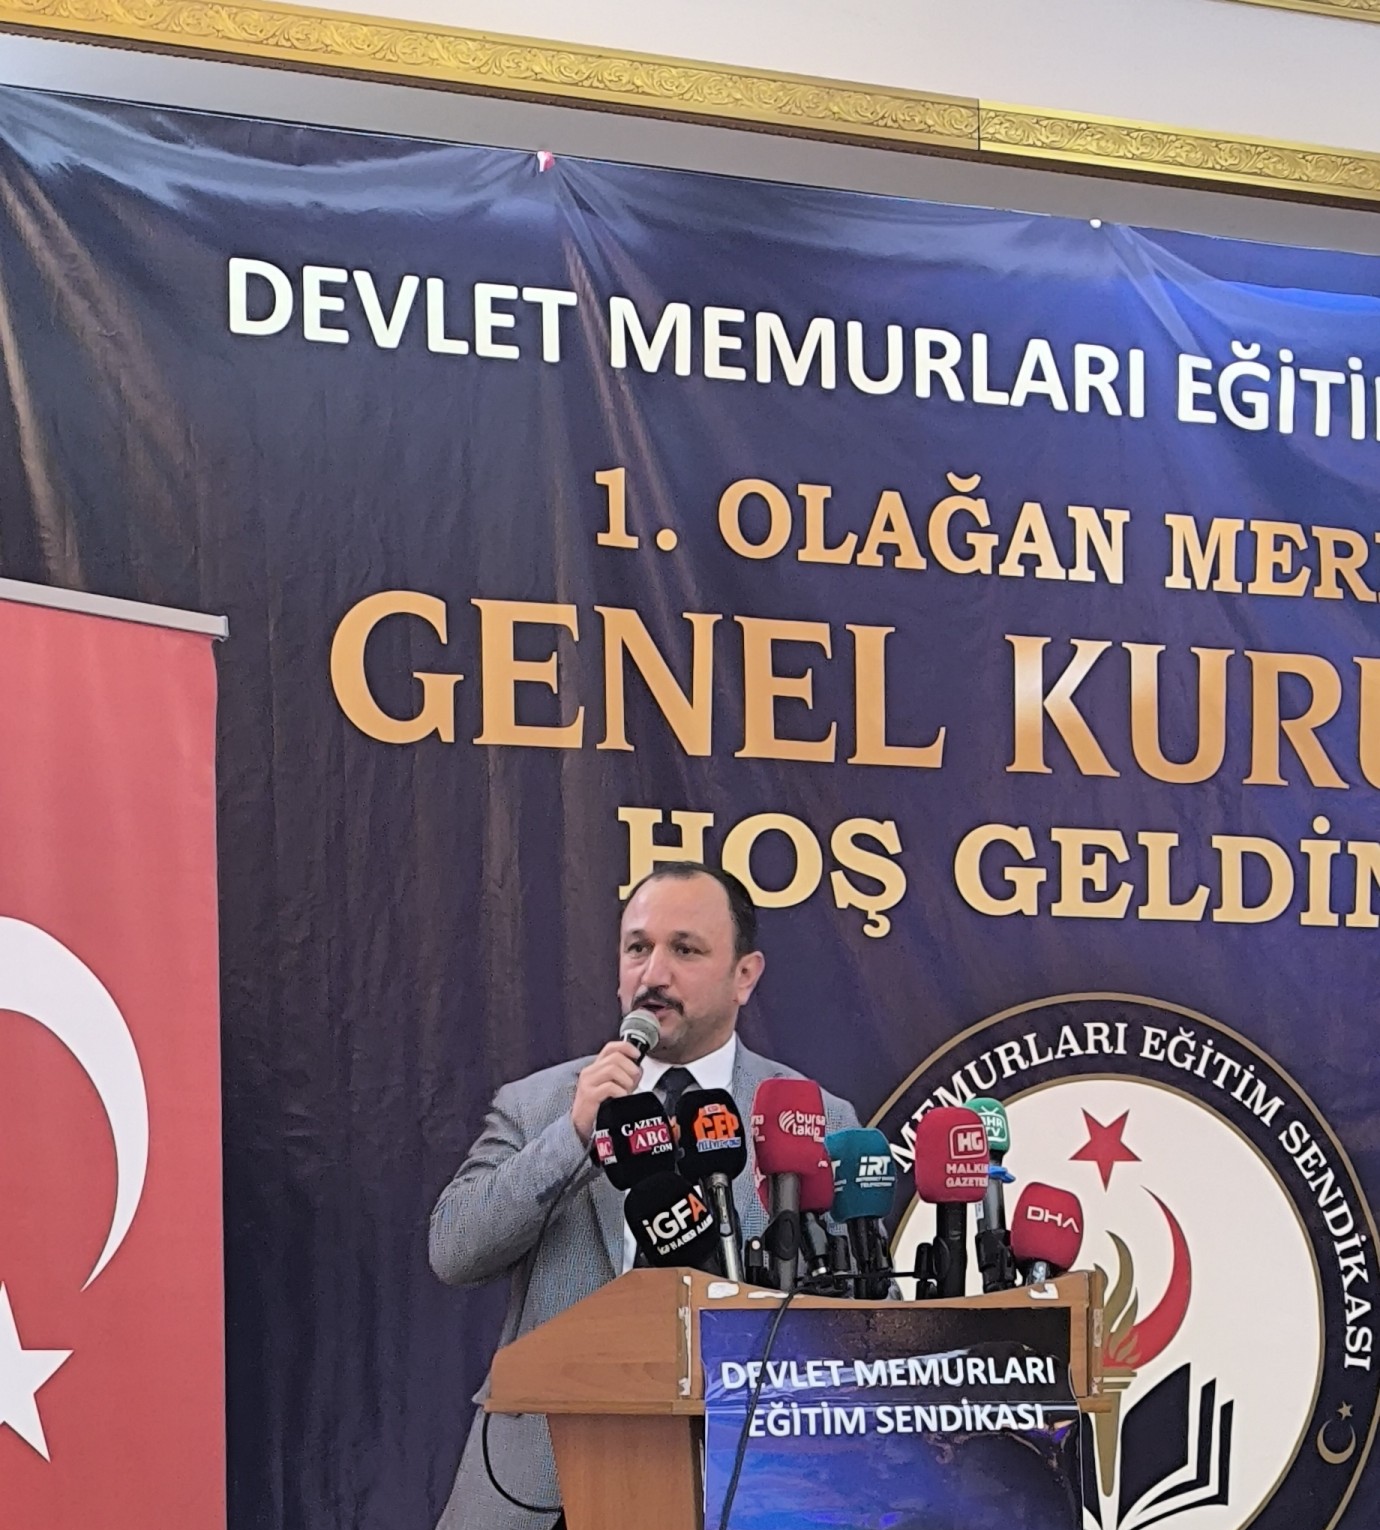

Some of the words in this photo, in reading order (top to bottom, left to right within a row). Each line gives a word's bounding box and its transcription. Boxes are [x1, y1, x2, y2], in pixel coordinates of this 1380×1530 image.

[227, 257, 577, 364] DEVLET
[609, 296, 1145, 419] MEMURLARI
[1177, 340, 1380, 442] EĞİTİ
[595, 467, 678, 553] 1.
[718, 472, 1131, 586] OLAĞAN
[1164, 512, 1380, 603] MER
[330, 590, 947, 769] GENEL
[1005, 634, 1380, 790] KUR
[617, 806, 907, 938] HOŞ
[620, 1116, 664, 1137] GAZETE
[635, 1127, 669, 1149] ABC
[957, 1130, 984, 1152] HG
[1139, 1025, 1286, 1128] EĞİTİM
[1277, 1119, 1374, 1371] SENDİKASI
[1027, 1205, 1080, 1234] DHA
[721, 1359, 845, 1390] DEVLET
[855, 1356, 1056, 1387] MEMURLARI
[749, 1401, 867, 1438] EĞİTİM
[875, 1398, 1045, 1435] SENDİKASI
